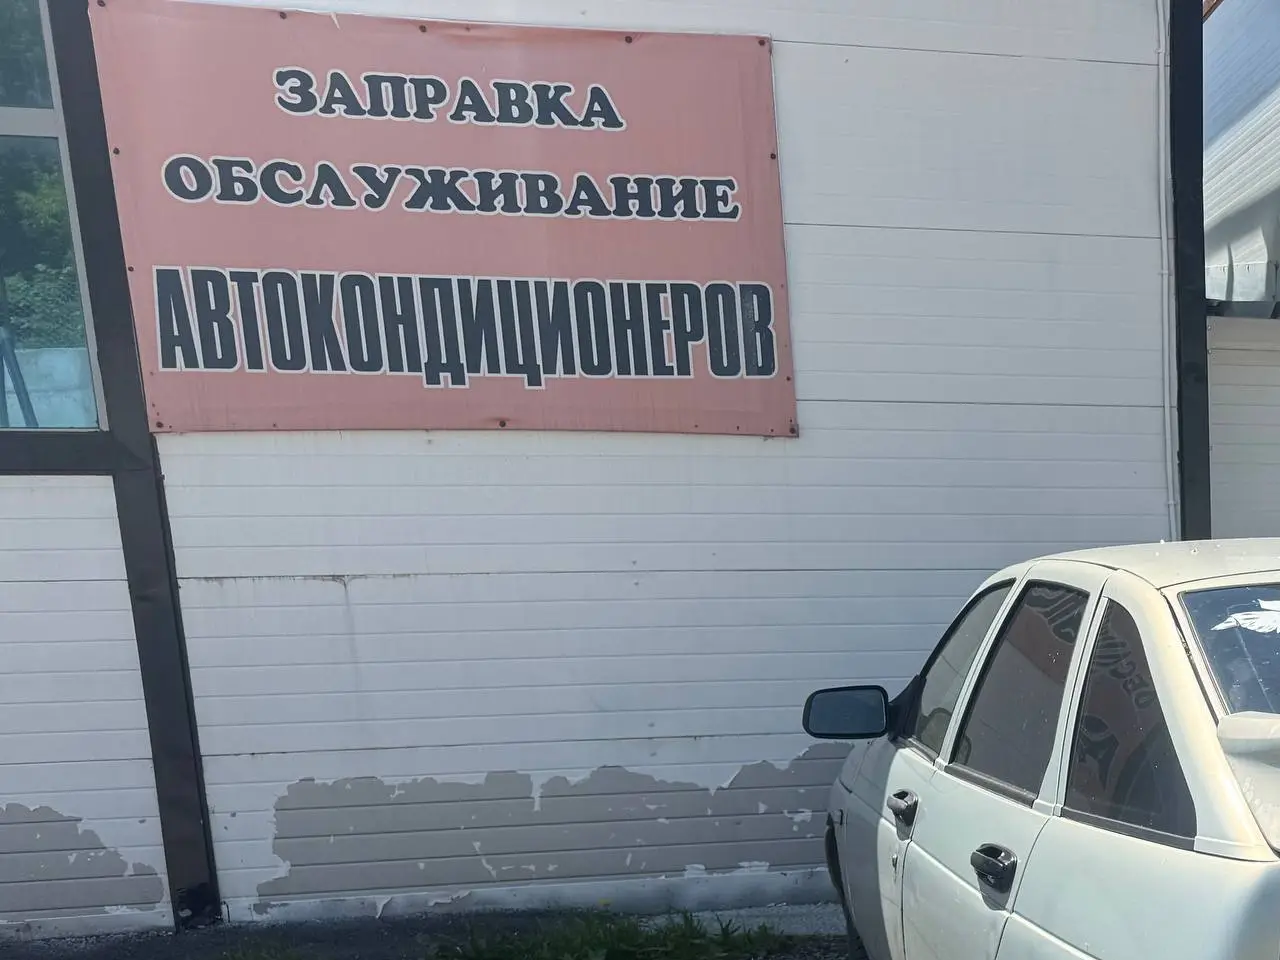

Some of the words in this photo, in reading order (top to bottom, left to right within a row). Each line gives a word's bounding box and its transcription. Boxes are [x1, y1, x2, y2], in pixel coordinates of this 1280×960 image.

[274, 67, 626, 131] ЗАПРАВКА
[163, 154, 740, 222] ОБСЛУЖИВАНИЕ
[154, 266, 777, 388] АВТОКОНДИЦИОНЕРОВ
